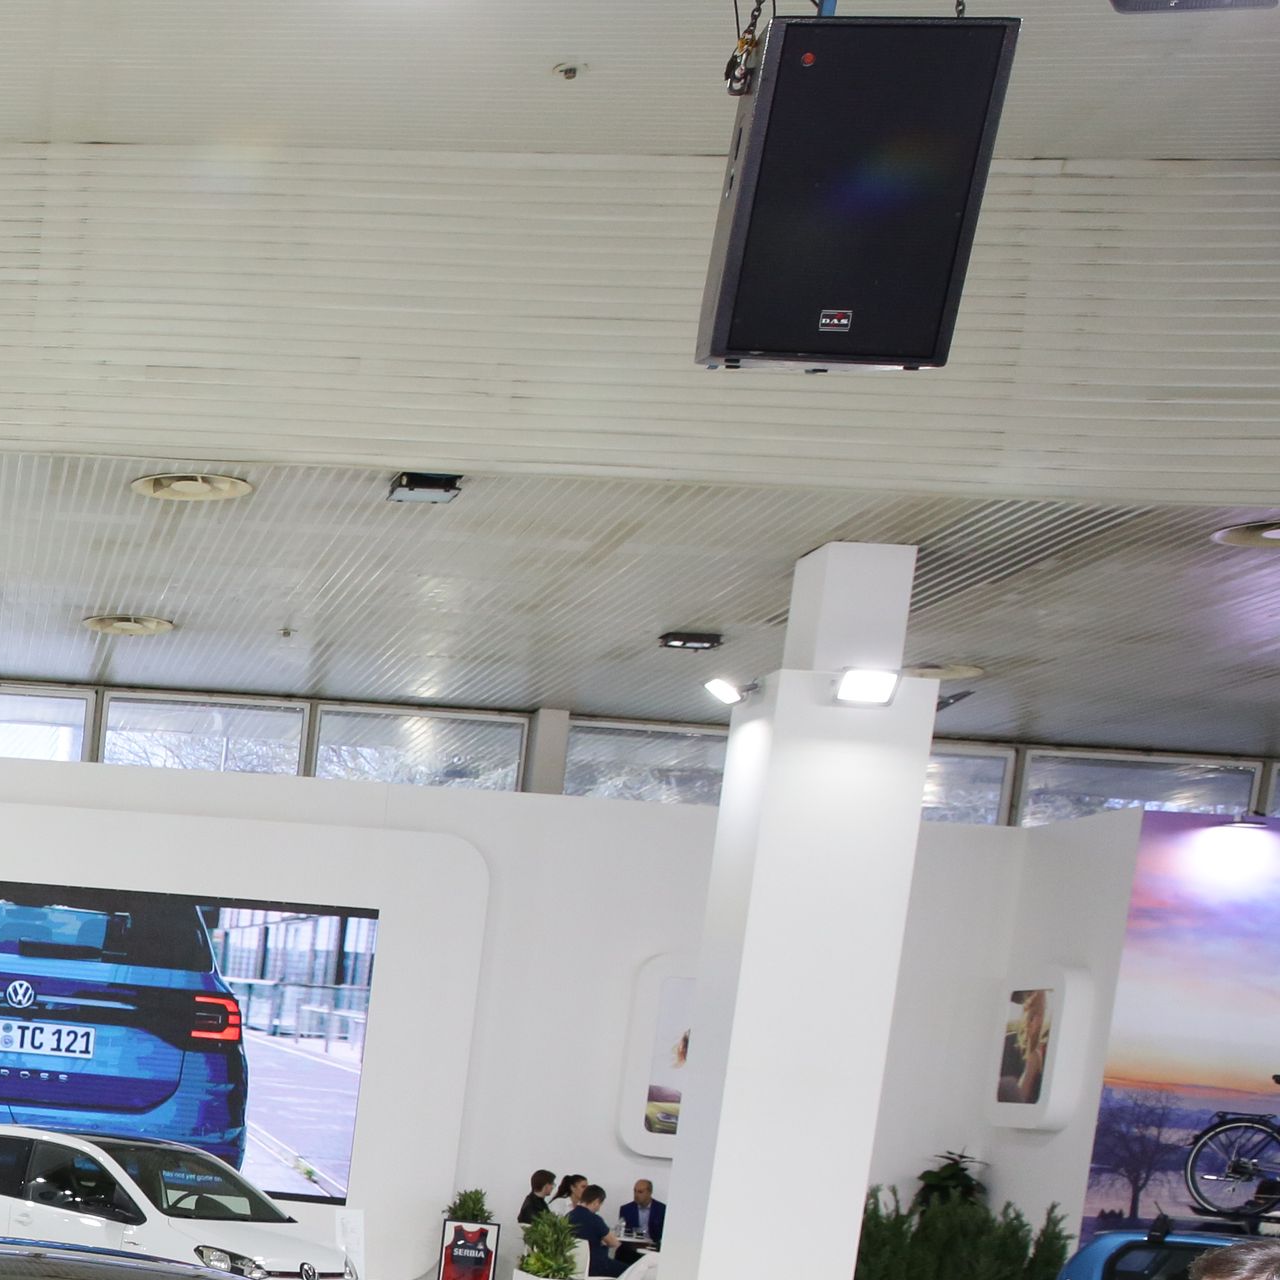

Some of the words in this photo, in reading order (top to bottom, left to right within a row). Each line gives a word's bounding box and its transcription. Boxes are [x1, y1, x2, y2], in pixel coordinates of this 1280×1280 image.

[17, 1025, 44, 1050] TC
[50, 1028, 92, 1055] 121
[453, 1247, 485, 1259] SERBIA
